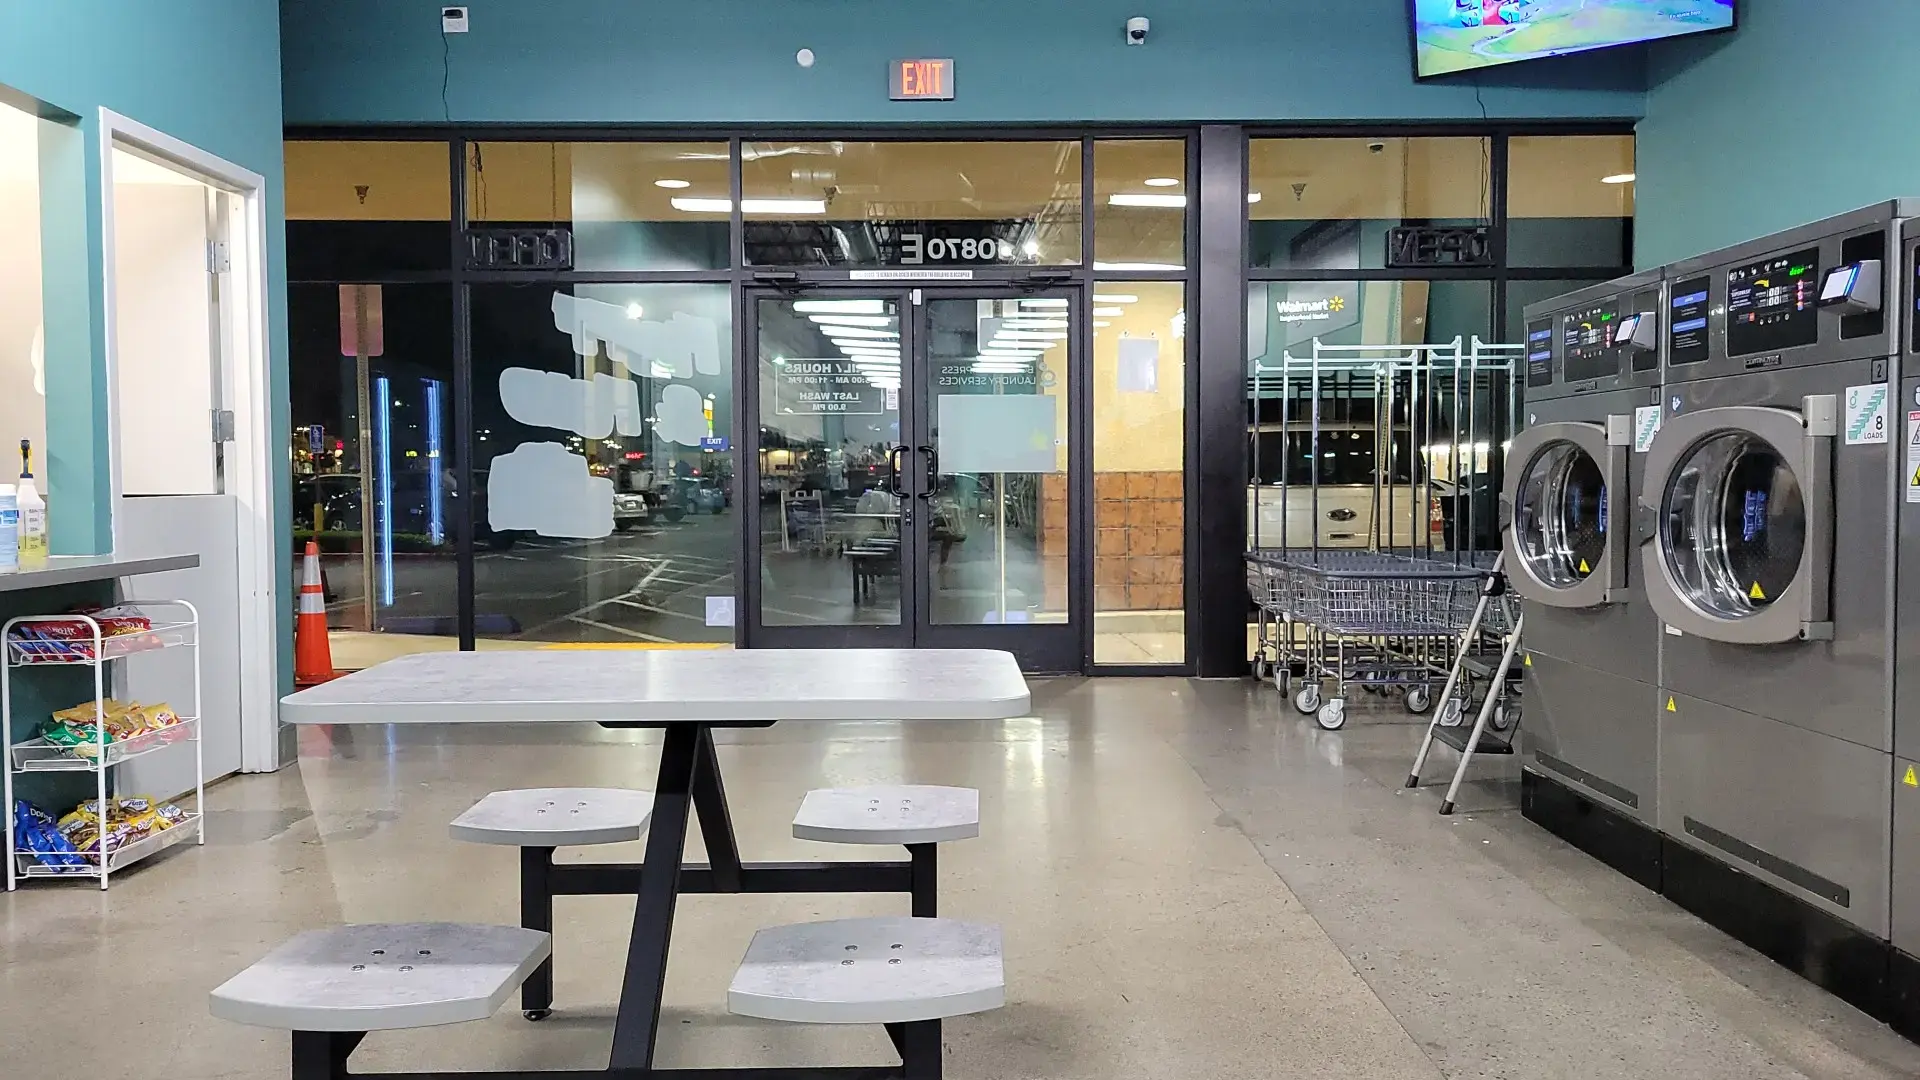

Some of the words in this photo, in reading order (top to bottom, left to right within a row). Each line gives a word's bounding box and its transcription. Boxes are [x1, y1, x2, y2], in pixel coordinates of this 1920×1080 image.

[902, 62, 942, 95] EXIT
[1276, 298, 1329, 314] Walmart
[1876, 363, 1882, 378] 2
[1875, 415, 1883, 430] 8
[1864, 431, 1884, 440] LOADS
